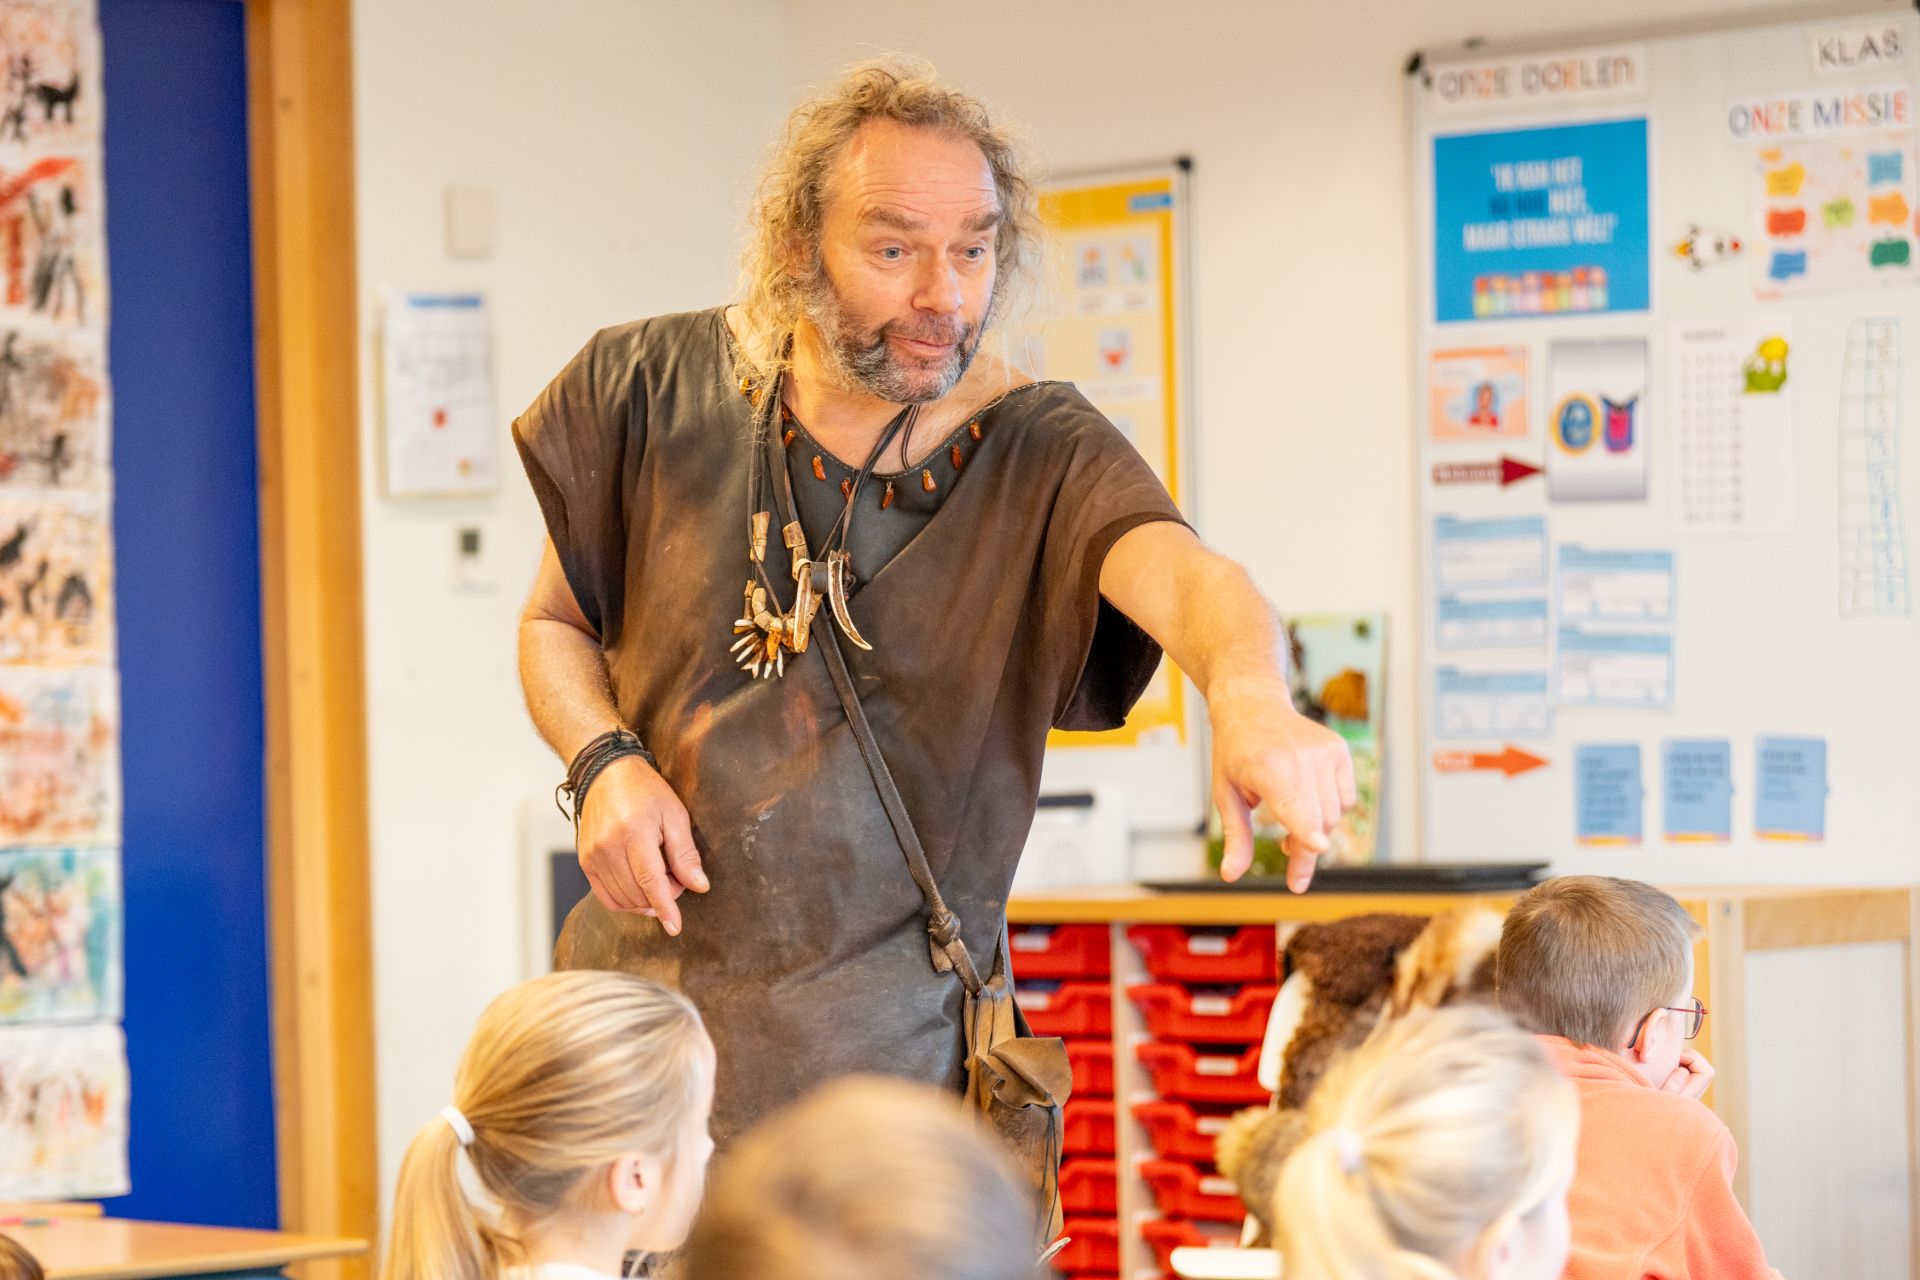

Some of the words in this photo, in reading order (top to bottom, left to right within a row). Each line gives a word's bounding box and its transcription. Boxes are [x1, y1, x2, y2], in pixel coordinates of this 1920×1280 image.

[1818, 28, 1900, 66] KLAS
[1728, 99, 1802, 138] ONZE
[1813, 90, 1907, 128] MISSIE
